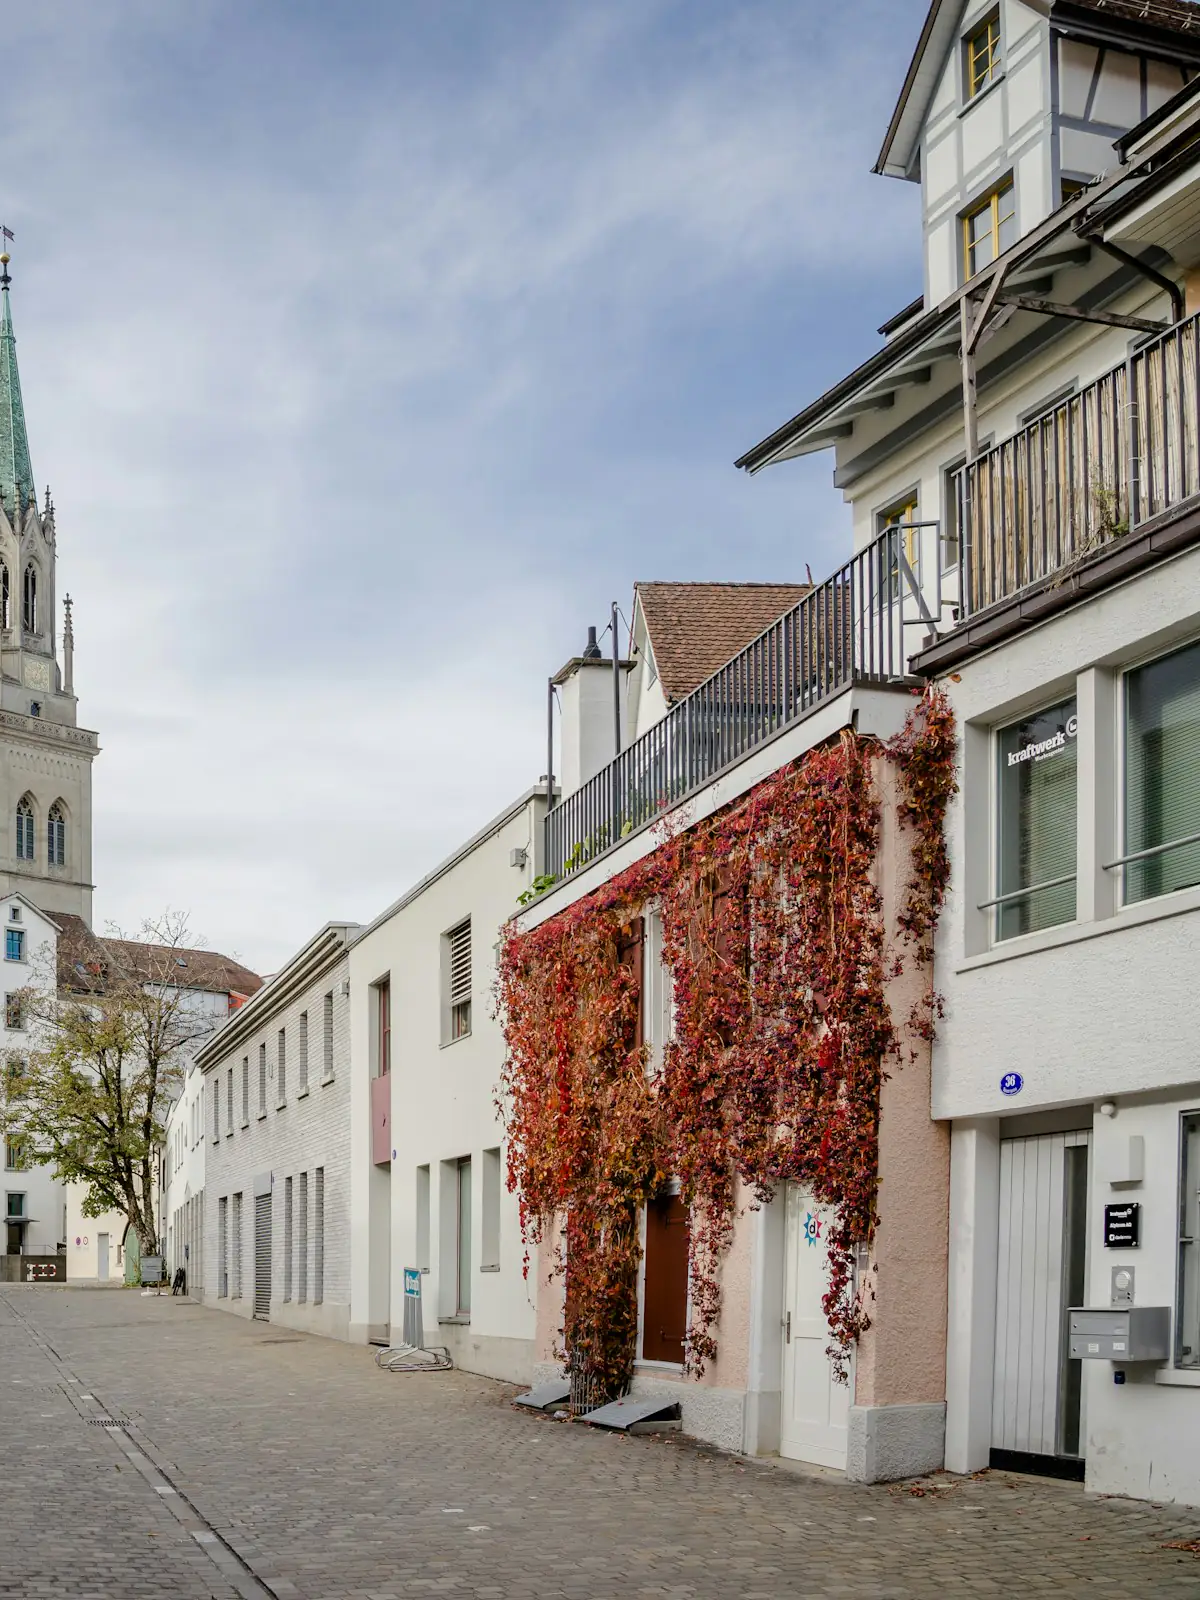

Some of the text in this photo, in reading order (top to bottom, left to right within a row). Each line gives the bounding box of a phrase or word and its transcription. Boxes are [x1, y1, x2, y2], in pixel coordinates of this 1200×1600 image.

[1008, 732, 1066, 766] kraftwerk
[1005, 1075, 1016, 1088] 36
[809, 1221, 816, 1234] d
